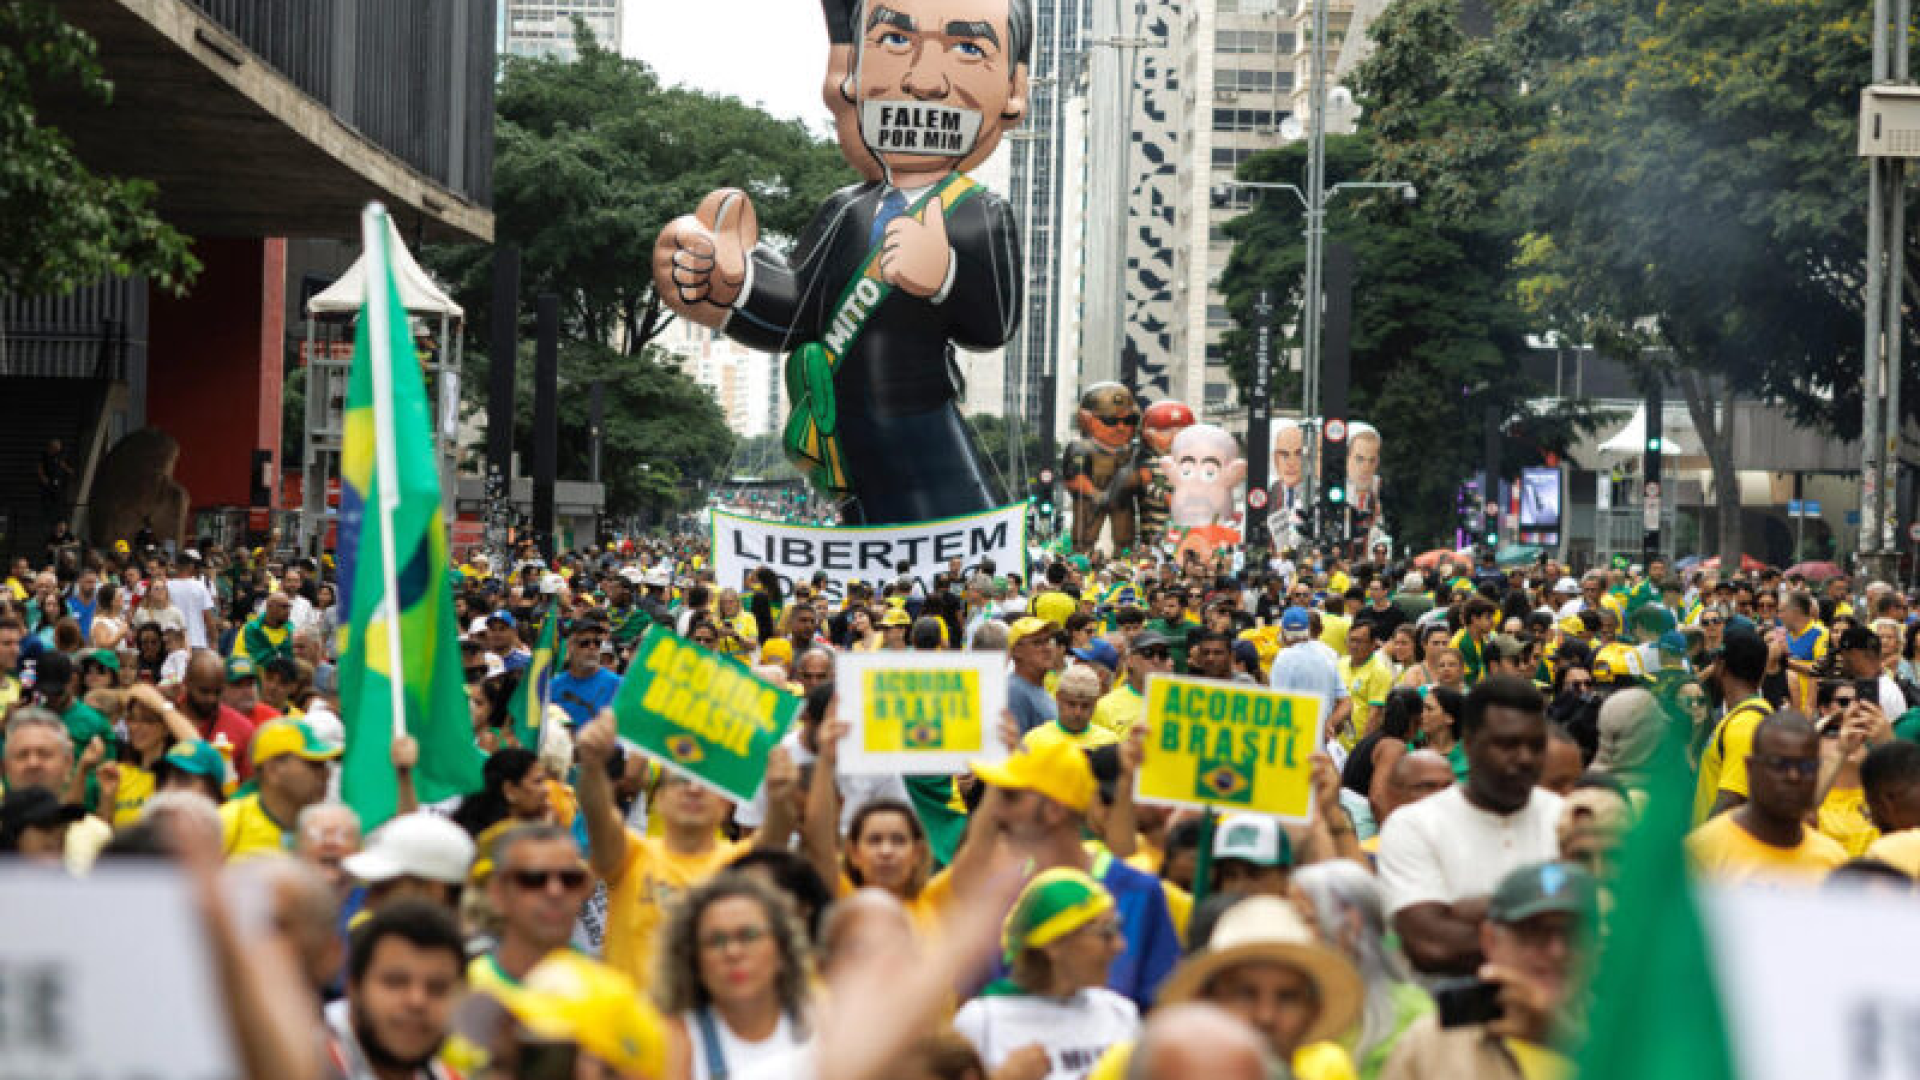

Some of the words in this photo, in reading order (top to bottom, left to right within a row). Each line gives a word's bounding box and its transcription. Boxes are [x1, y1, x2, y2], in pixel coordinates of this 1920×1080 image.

[878, 129, 918, 147] POR
[923, 131, 963, 149] MIM
[881, 106, 961, 131] FALEM
[825, 278, 879, 355] MITO
[732, 520, 1008, 570] LIBERTEM
[642, 675, 751, 758] BRASIL
[875, 697, 971, 721] BRASIL
[1161, 721, 1296, 768] BRASIL
